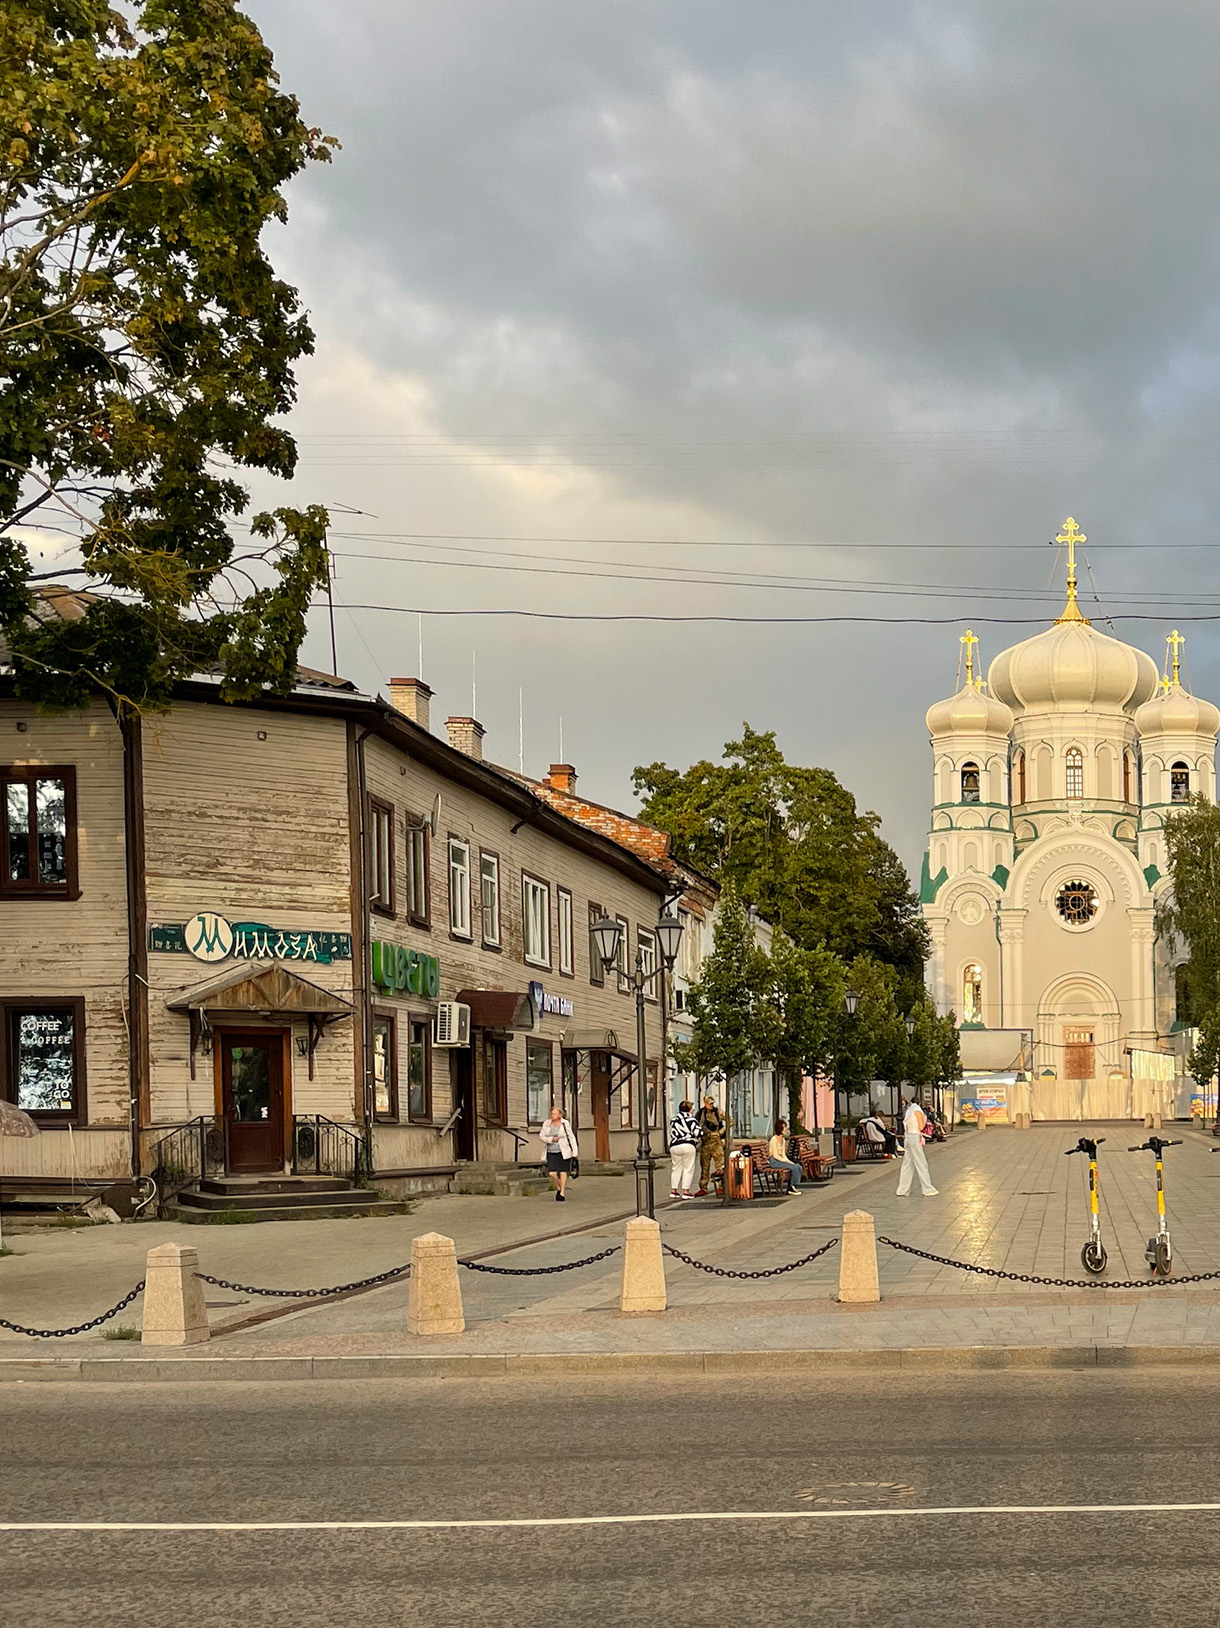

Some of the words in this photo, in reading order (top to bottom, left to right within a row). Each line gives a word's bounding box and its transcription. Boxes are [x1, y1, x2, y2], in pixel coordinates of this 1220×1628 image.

[373, 941, 440, 997] ЦВЕТЫ
[21, 1021, 60, 1031] COFFEE
[53, 1090, 70, 1099] GO
